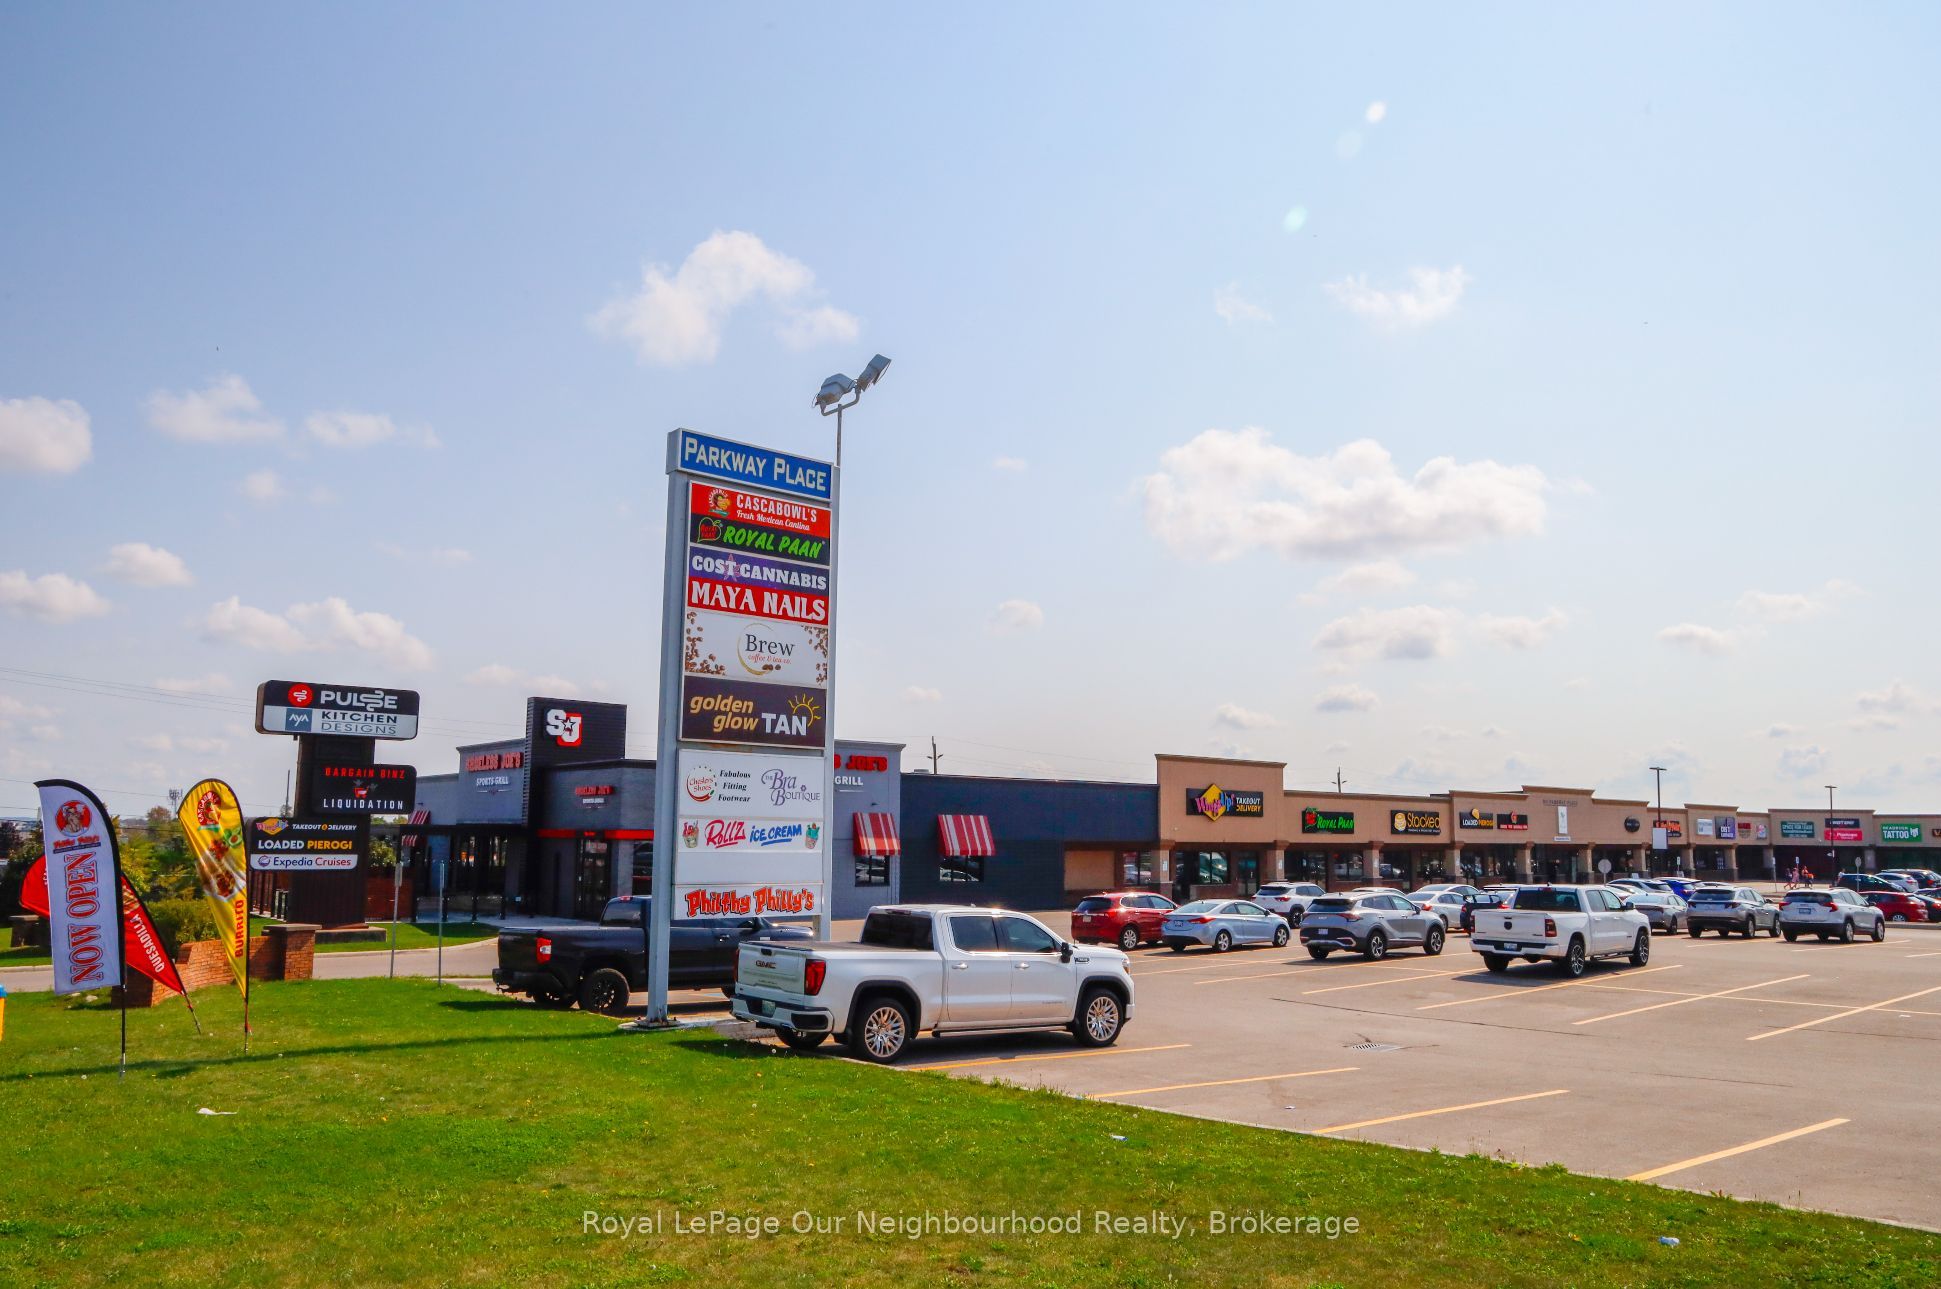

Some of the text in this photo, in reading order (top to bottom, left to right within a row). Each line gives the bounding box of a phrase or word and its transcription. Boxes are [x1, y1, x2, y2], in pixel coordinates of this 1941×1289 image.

[685, 437, 826, 491] PARKWAY PLACE
[737, 494, 817, 523] CASCABOWL'S
[737, 510, 754, 521] Fresh
[723, 526, 774, 550] ROYAL
[778, 535, 823, 559] PAAN
[691, 555, 827, 590] COST CANNABIS
[691, 581, 826, 621] MAYA NAILS
[745, 634, 795, 657] Brew
[320, 690, 398, 712] PULSE
[690, 695, 754, 714] golden
[321, 711, 397, 724] KITCHEN
[713, 712, 807, 736] glow TAN
[321, 723, 397, 734] DESIGNS
[325, 767, 375, 778] BARGAIN
[720, 770, 751, 778] Fabulous
[761, 769, 797, 789] Bra
[834, 775, 864, 786] GRILL
[723, 782, 747, 791] Fitting
[323, 799, 403, 810] LIQUIDATION
[718, 794, 751, 802] Footwear
[1236, 797, 1260, 805] TAKEOUT
[767, 824, 802, 840] CREAM
[1883, 830, 1909, 838] TATTOO
[258, 840, 352, 850] LOADED PIEROGI
[273, 857, 351, 868] Expedia Cruises
[64, 851, 100, 918] OPEN
[685, 886, 814, 917] Philthy Philly's
[234, 899, 244, 958] BURRITO
[129, 913, 164, 973] QUESADILLA
[67, 924, 104, 985] NOW
[756, 960, 776, 969] GMC
